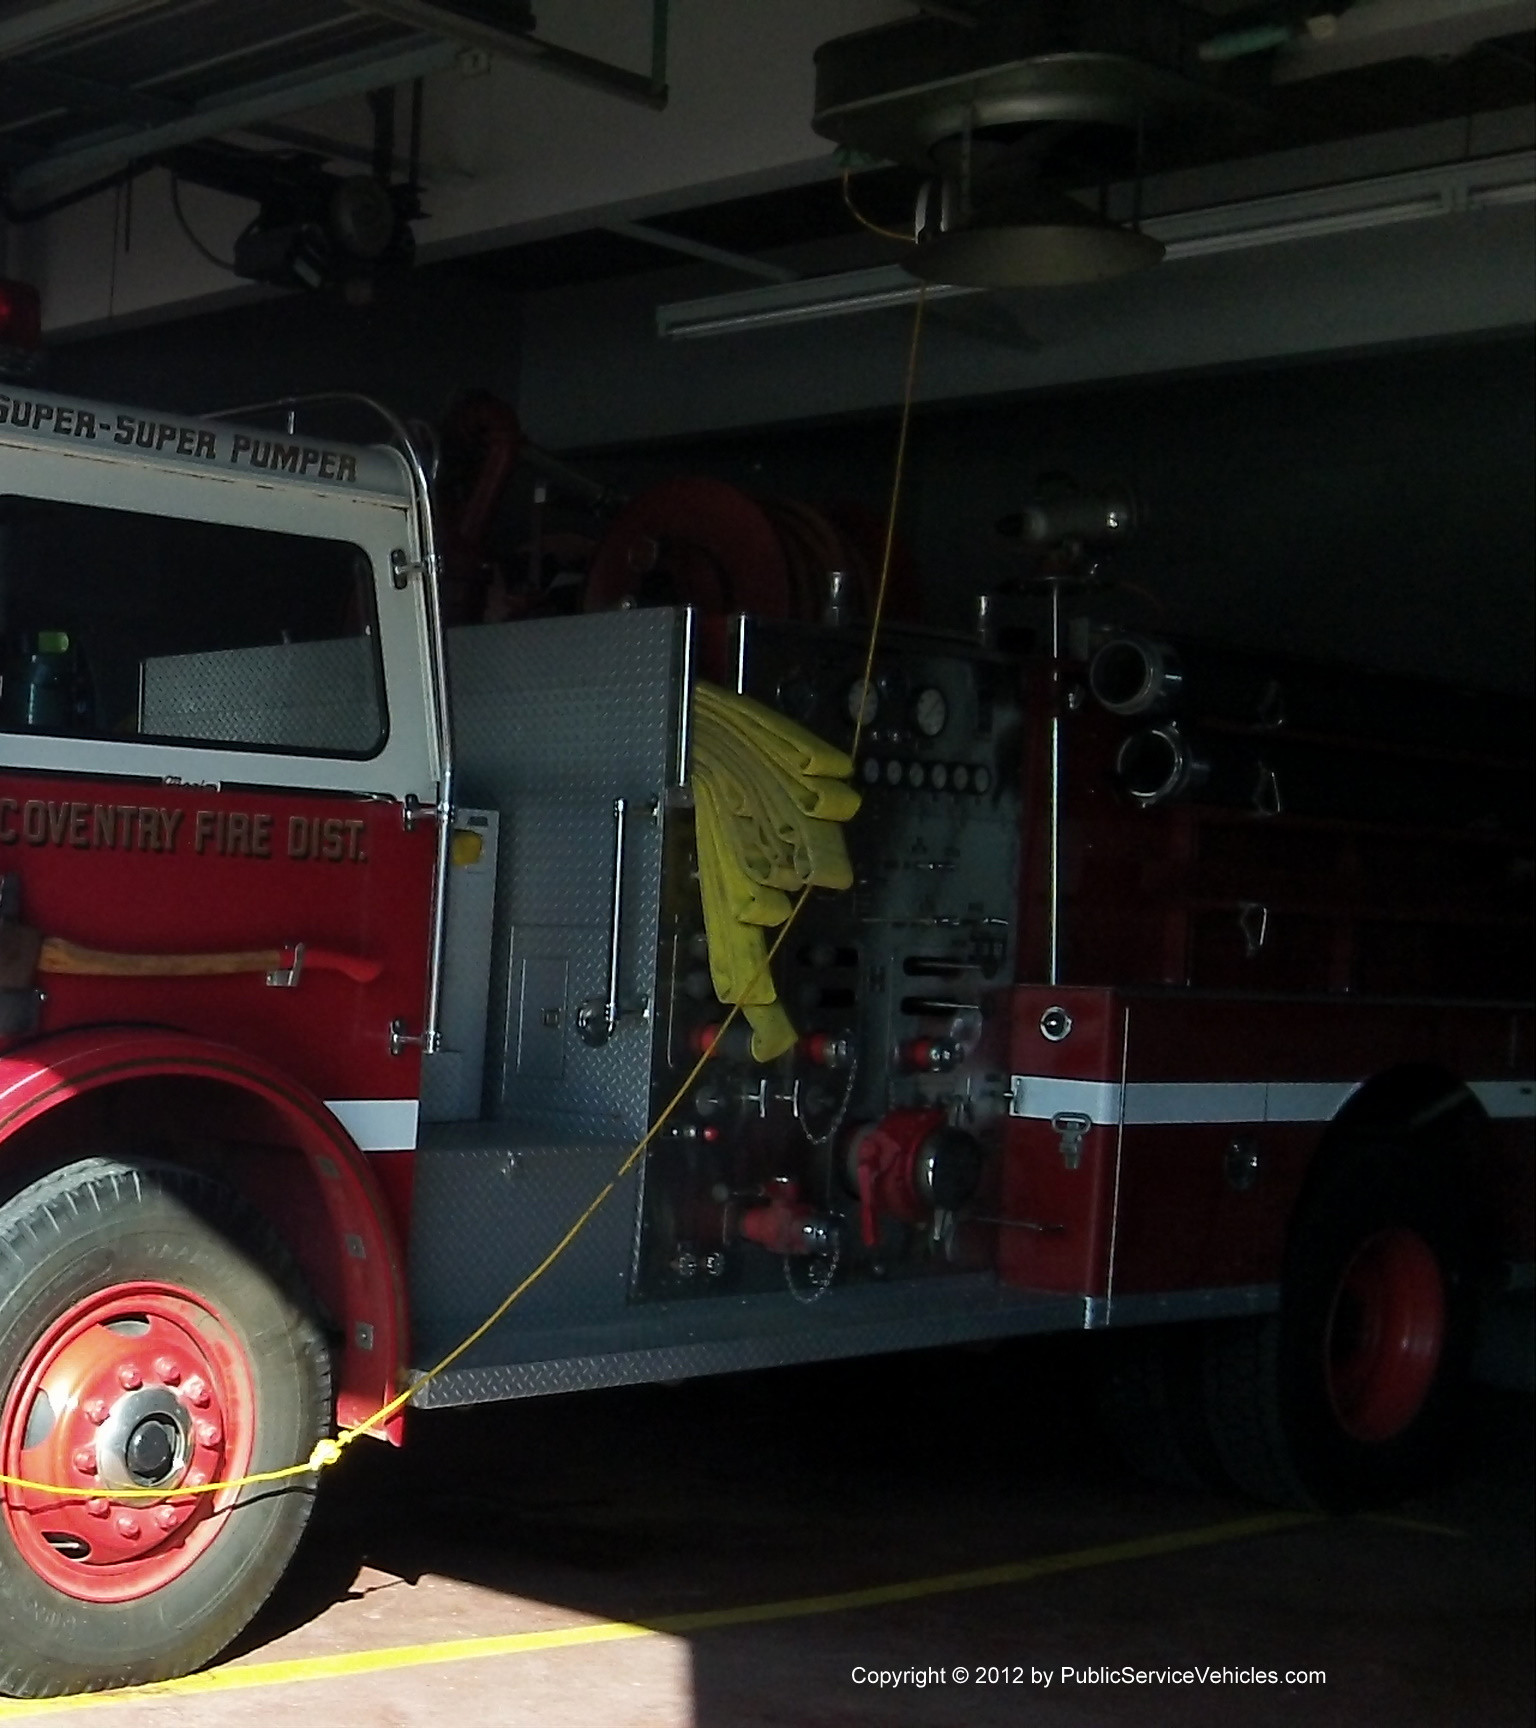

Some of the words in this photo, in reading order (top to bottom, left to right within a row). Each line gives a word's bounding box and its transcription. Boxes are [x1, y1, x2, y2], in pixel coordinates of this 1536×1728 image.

[231, 435, 357, 482] PUMPER
[195, 810, 272, 857] FIRE
[288, 816, 369, 861] DIST.
